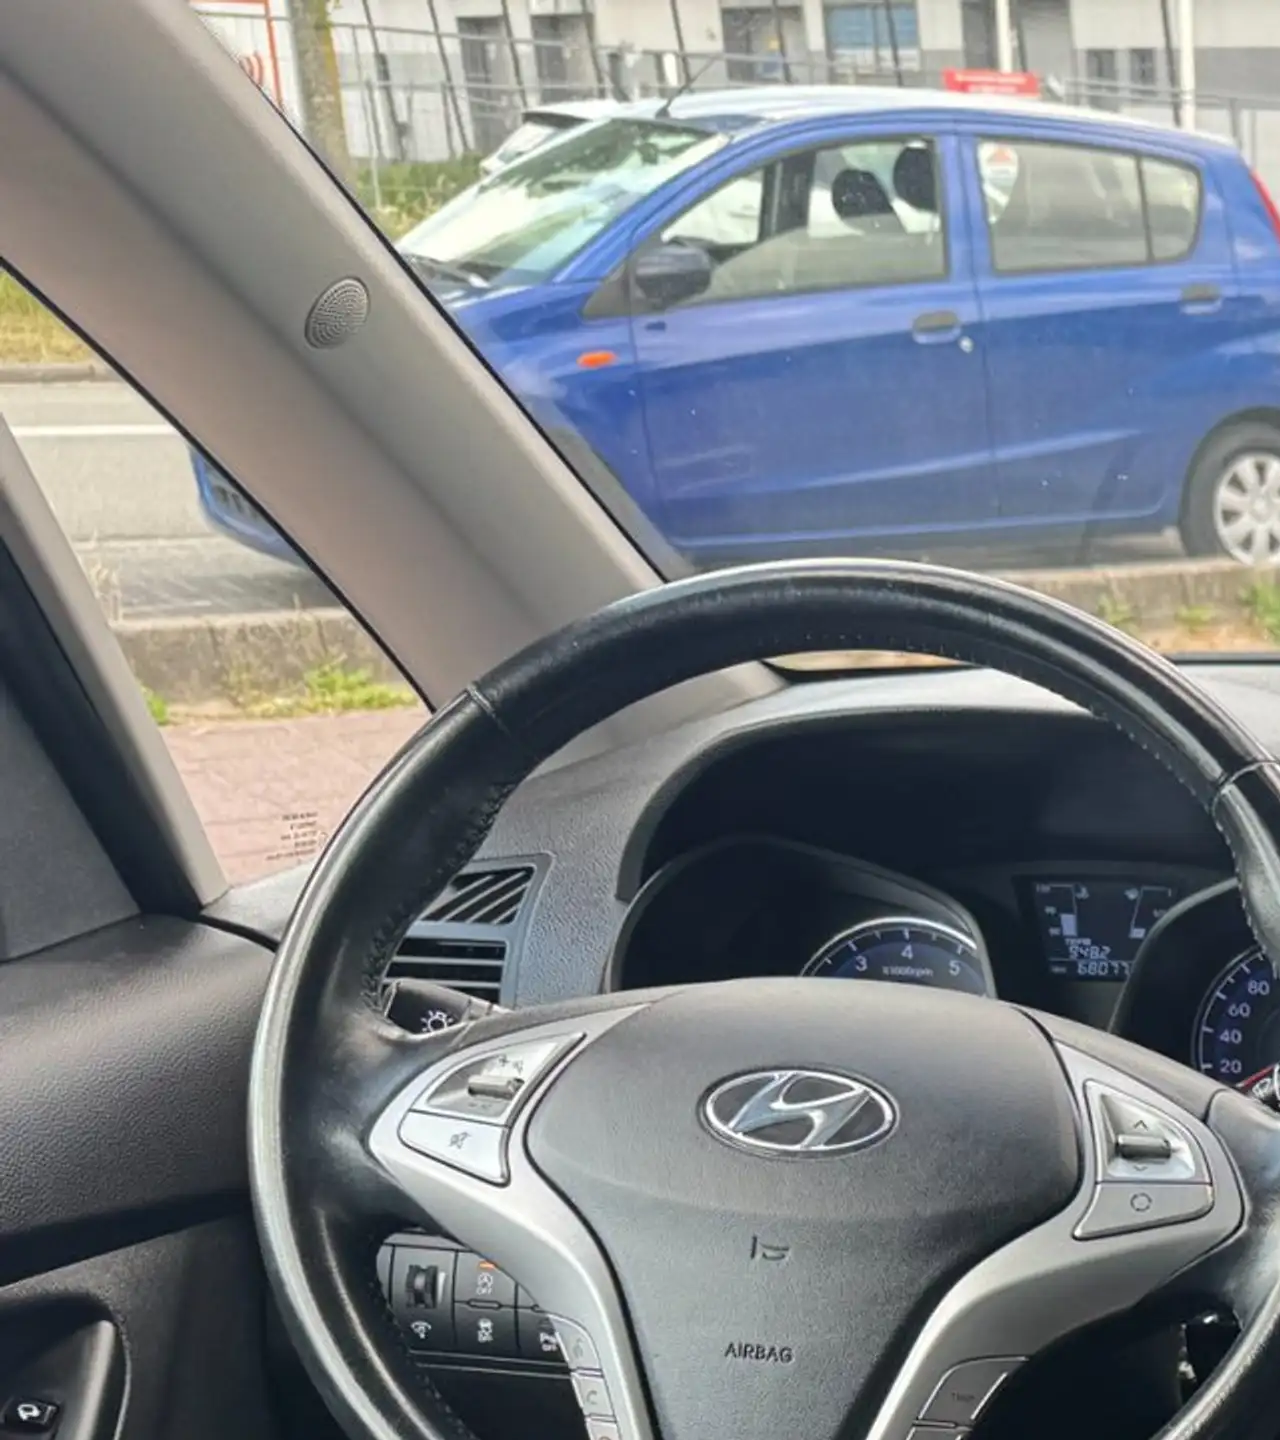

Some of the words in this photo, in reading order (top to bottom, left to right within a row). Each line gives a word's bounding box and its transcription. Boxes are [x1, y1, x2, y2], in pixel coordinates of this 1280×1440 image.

[901, 944, 914, 960] 4
[855, 955, 868, 971] 3
[949, 960, 961, 976] 5
[1247, 980, 1270, 995] 80
[1228, 1002, 1250, 1018] 60
[1219, 1029, 1242, 1044] 40
[1220, 1059, 1242, 1073] 20
[476, 1286, 494, 1296] OFF
[724, 1341, 794, 1364] AIRBAG
